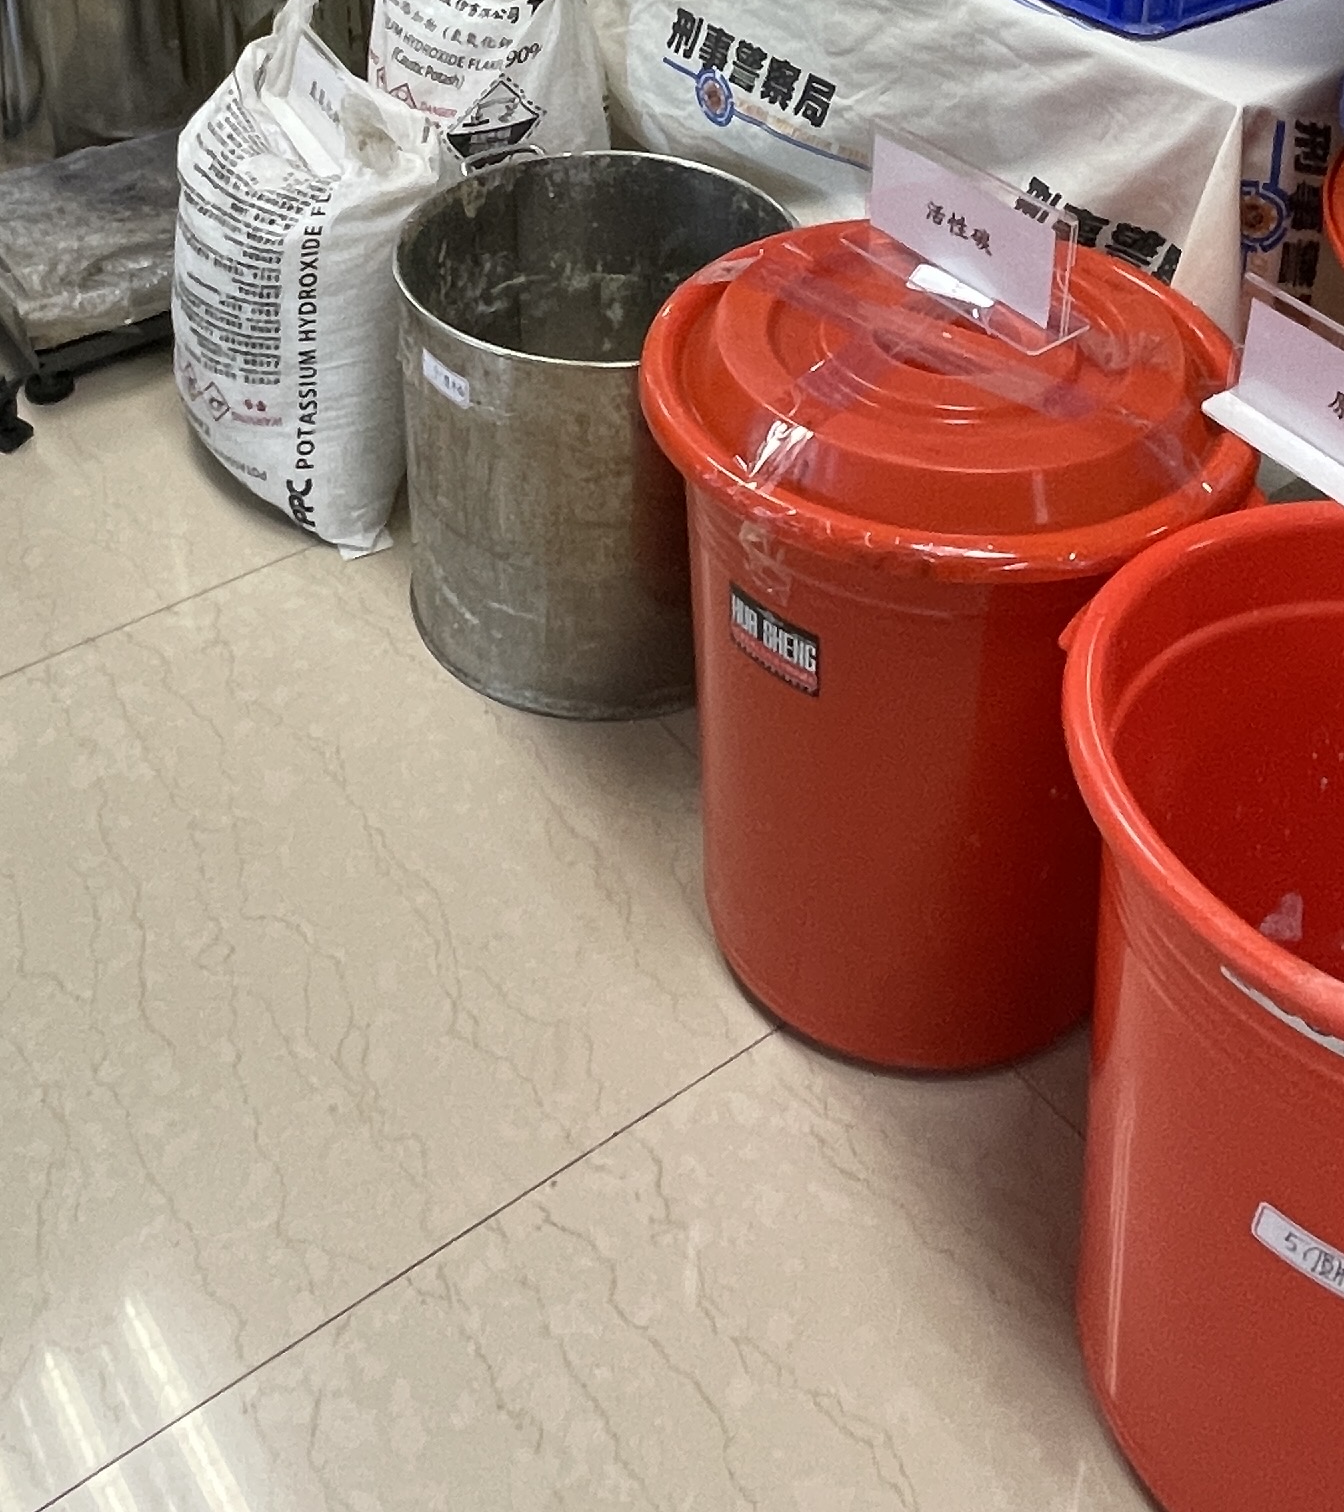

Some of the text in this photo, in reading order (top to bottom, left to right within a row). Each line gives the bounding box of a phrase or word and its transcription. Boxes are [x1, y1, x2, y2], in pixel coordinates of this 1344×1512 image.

[403, 33, 466, 69] HYDROXIDE
[666, 7, 837, 128] 刑事警察局
[926, 200, 993, 257] 活性碳
[1278, 119, 1333, 304] 刑事警
[297, 225, 324, 343] HYDROXIDE
[294, 348, 319, 470] POTASSIUM
